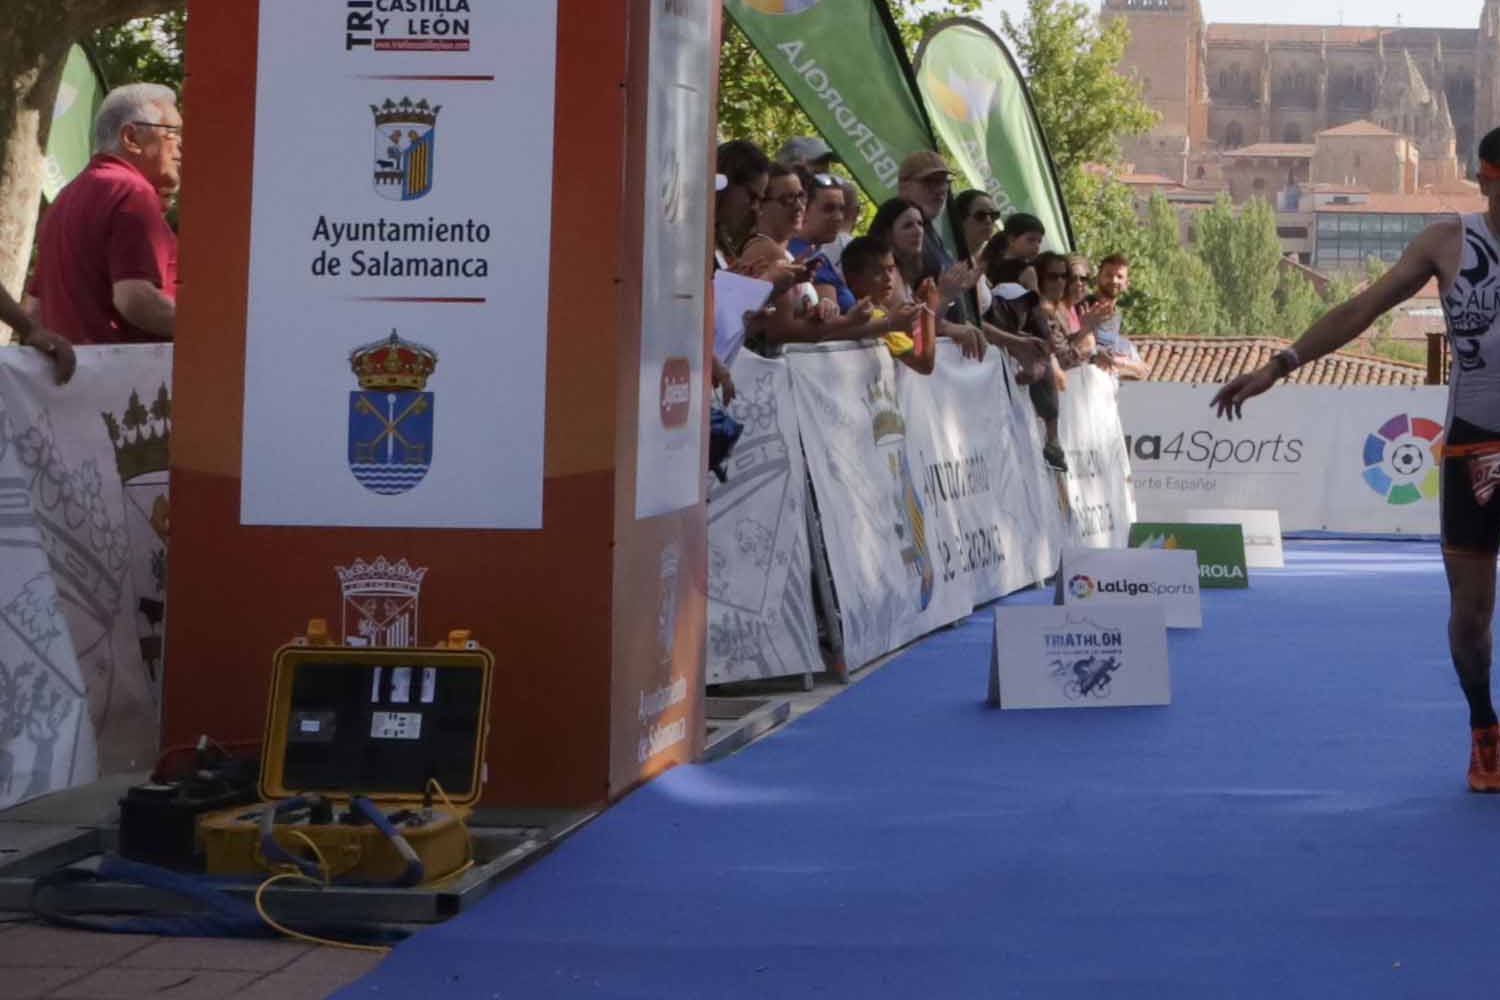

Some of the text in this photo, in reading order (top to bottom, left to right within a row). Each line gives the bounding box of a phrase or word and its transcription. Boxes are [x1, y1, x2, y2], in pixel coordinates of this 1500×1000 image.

[376, 12, 469, 35] Y LEÓN
[312, 215, 491, 246] Ayuntamiento
[311, 251, 488, 279] de Salamanca
[1097, 574, 1194, 596] LaLigaSports
